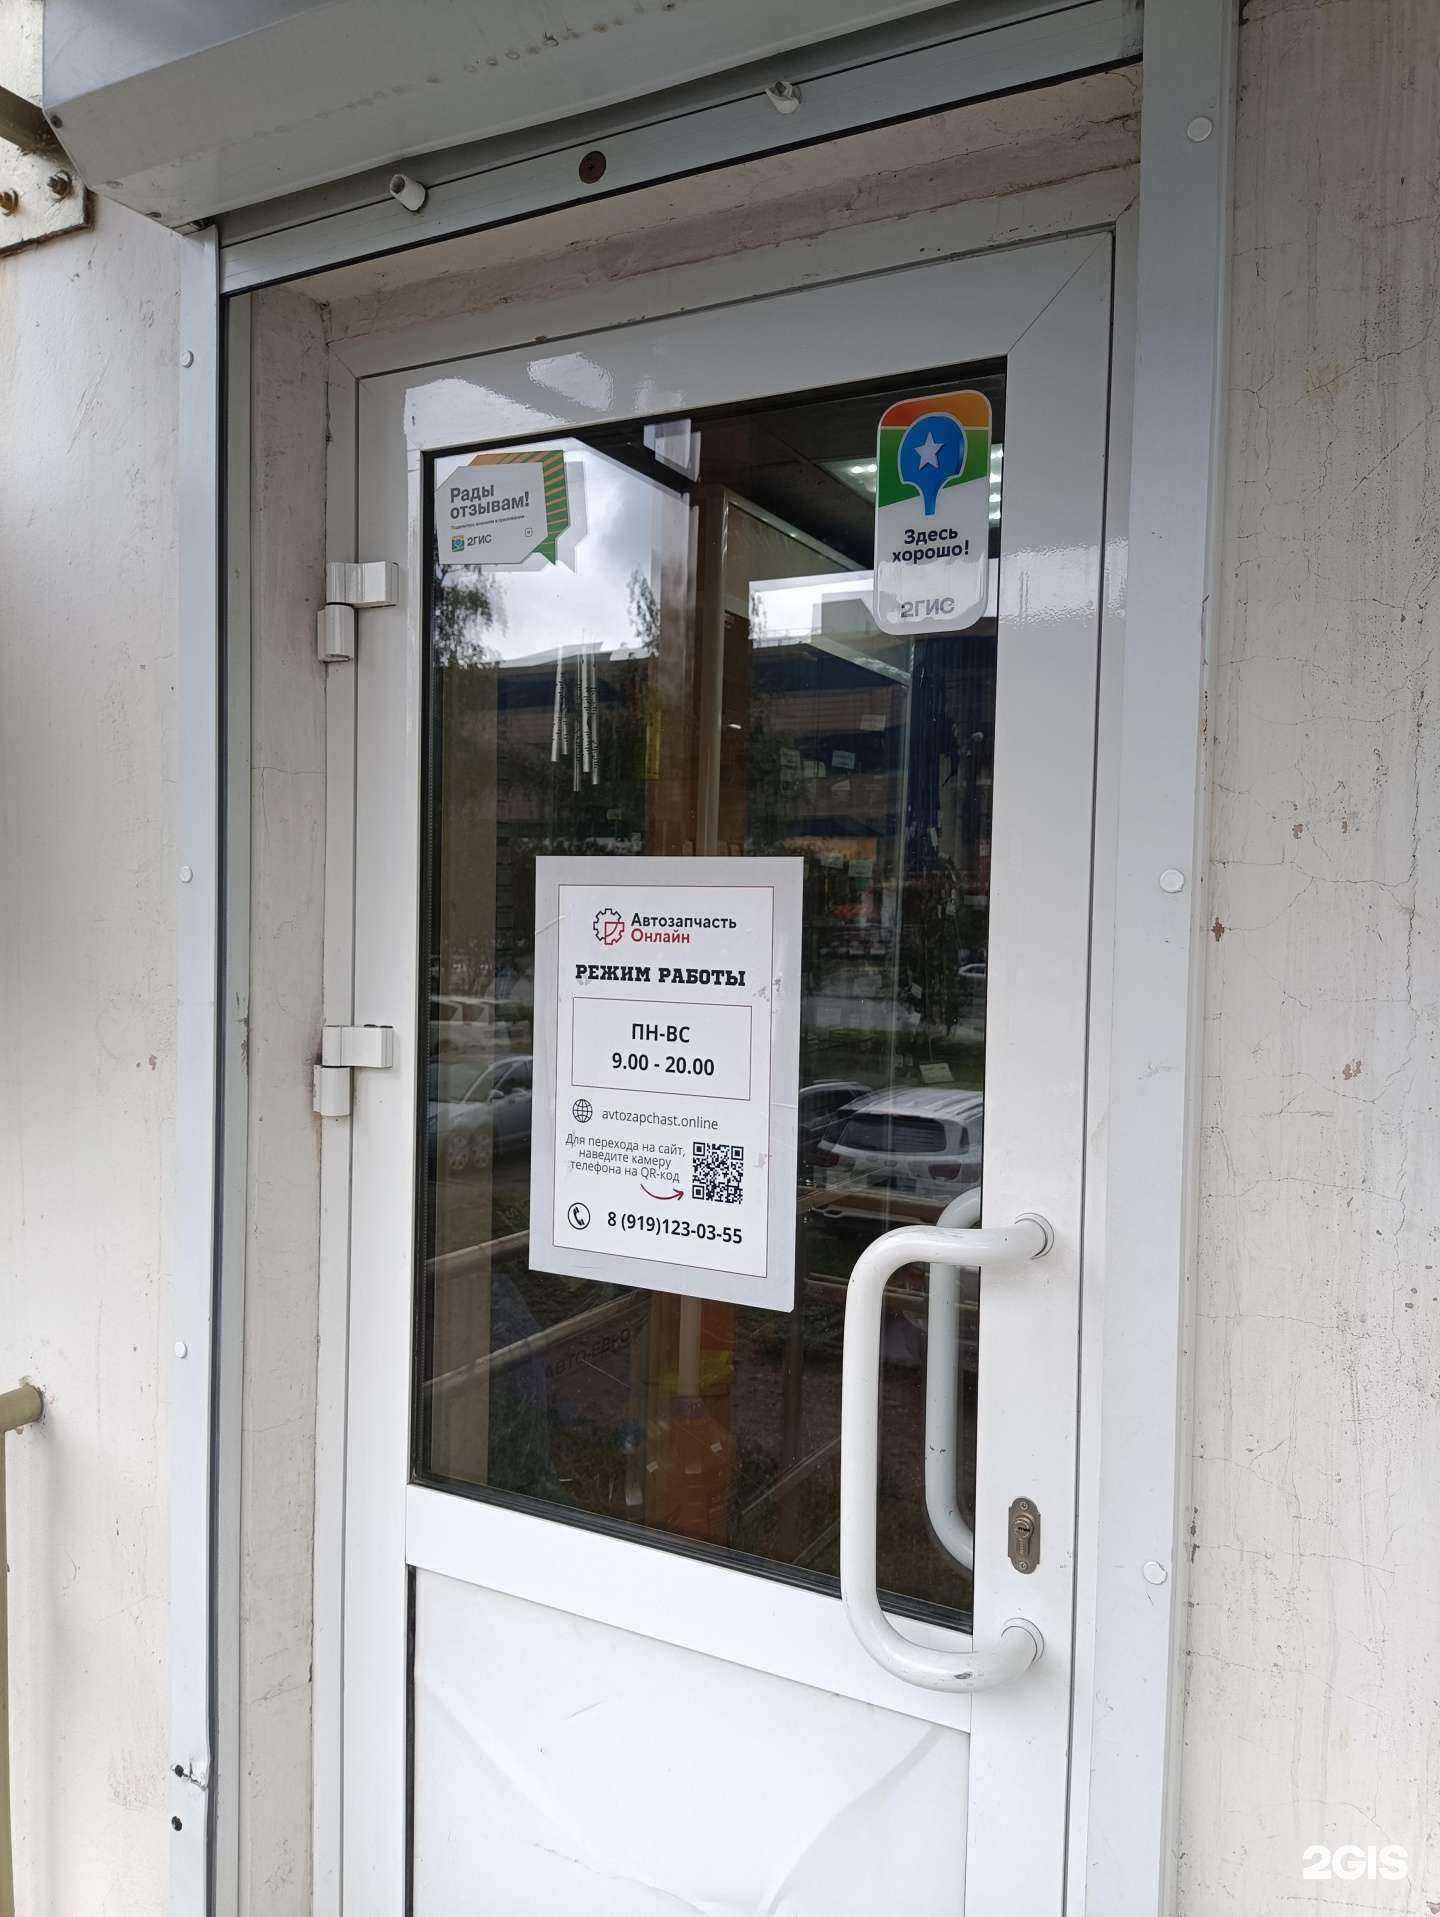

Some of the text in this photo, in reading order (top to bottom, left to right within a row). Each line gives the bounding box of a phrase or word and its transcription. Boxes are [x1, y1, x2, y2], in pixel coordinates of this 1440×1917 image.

[450, 485, 494, 503] Рады
[450, 491, 530, 519] отзывам!
[467, 534, 492, 546] 2ГИС
[904, 528, 958, 545] Здесь
[892, 540, 969, 564] хорошо!
[901, 597, 955, 618] 2ГИС
[631, 913, 737, 929] Автозапчасть
[631, 928, 690, 944] Онлайн
[575, 964, 746, 986] РЕЖИМ РАБОТЫ
[631, 1023, 690, 1043] ПН-ВС
[612, 1053, 649, 1070] 9.00
[665, 1057, 715, 1075] 20.00
[602, 1109, 719, 1130] avtozapchast.online
[565, 1133, 685, 1157] Для перехода на сайт,
[579, 1149, 672, 1170] наведите камеру
[570, 1160, 680, 1183] телефона на QR-код
[607, 1211, 742, 1244] 8 (919)123-03-55
